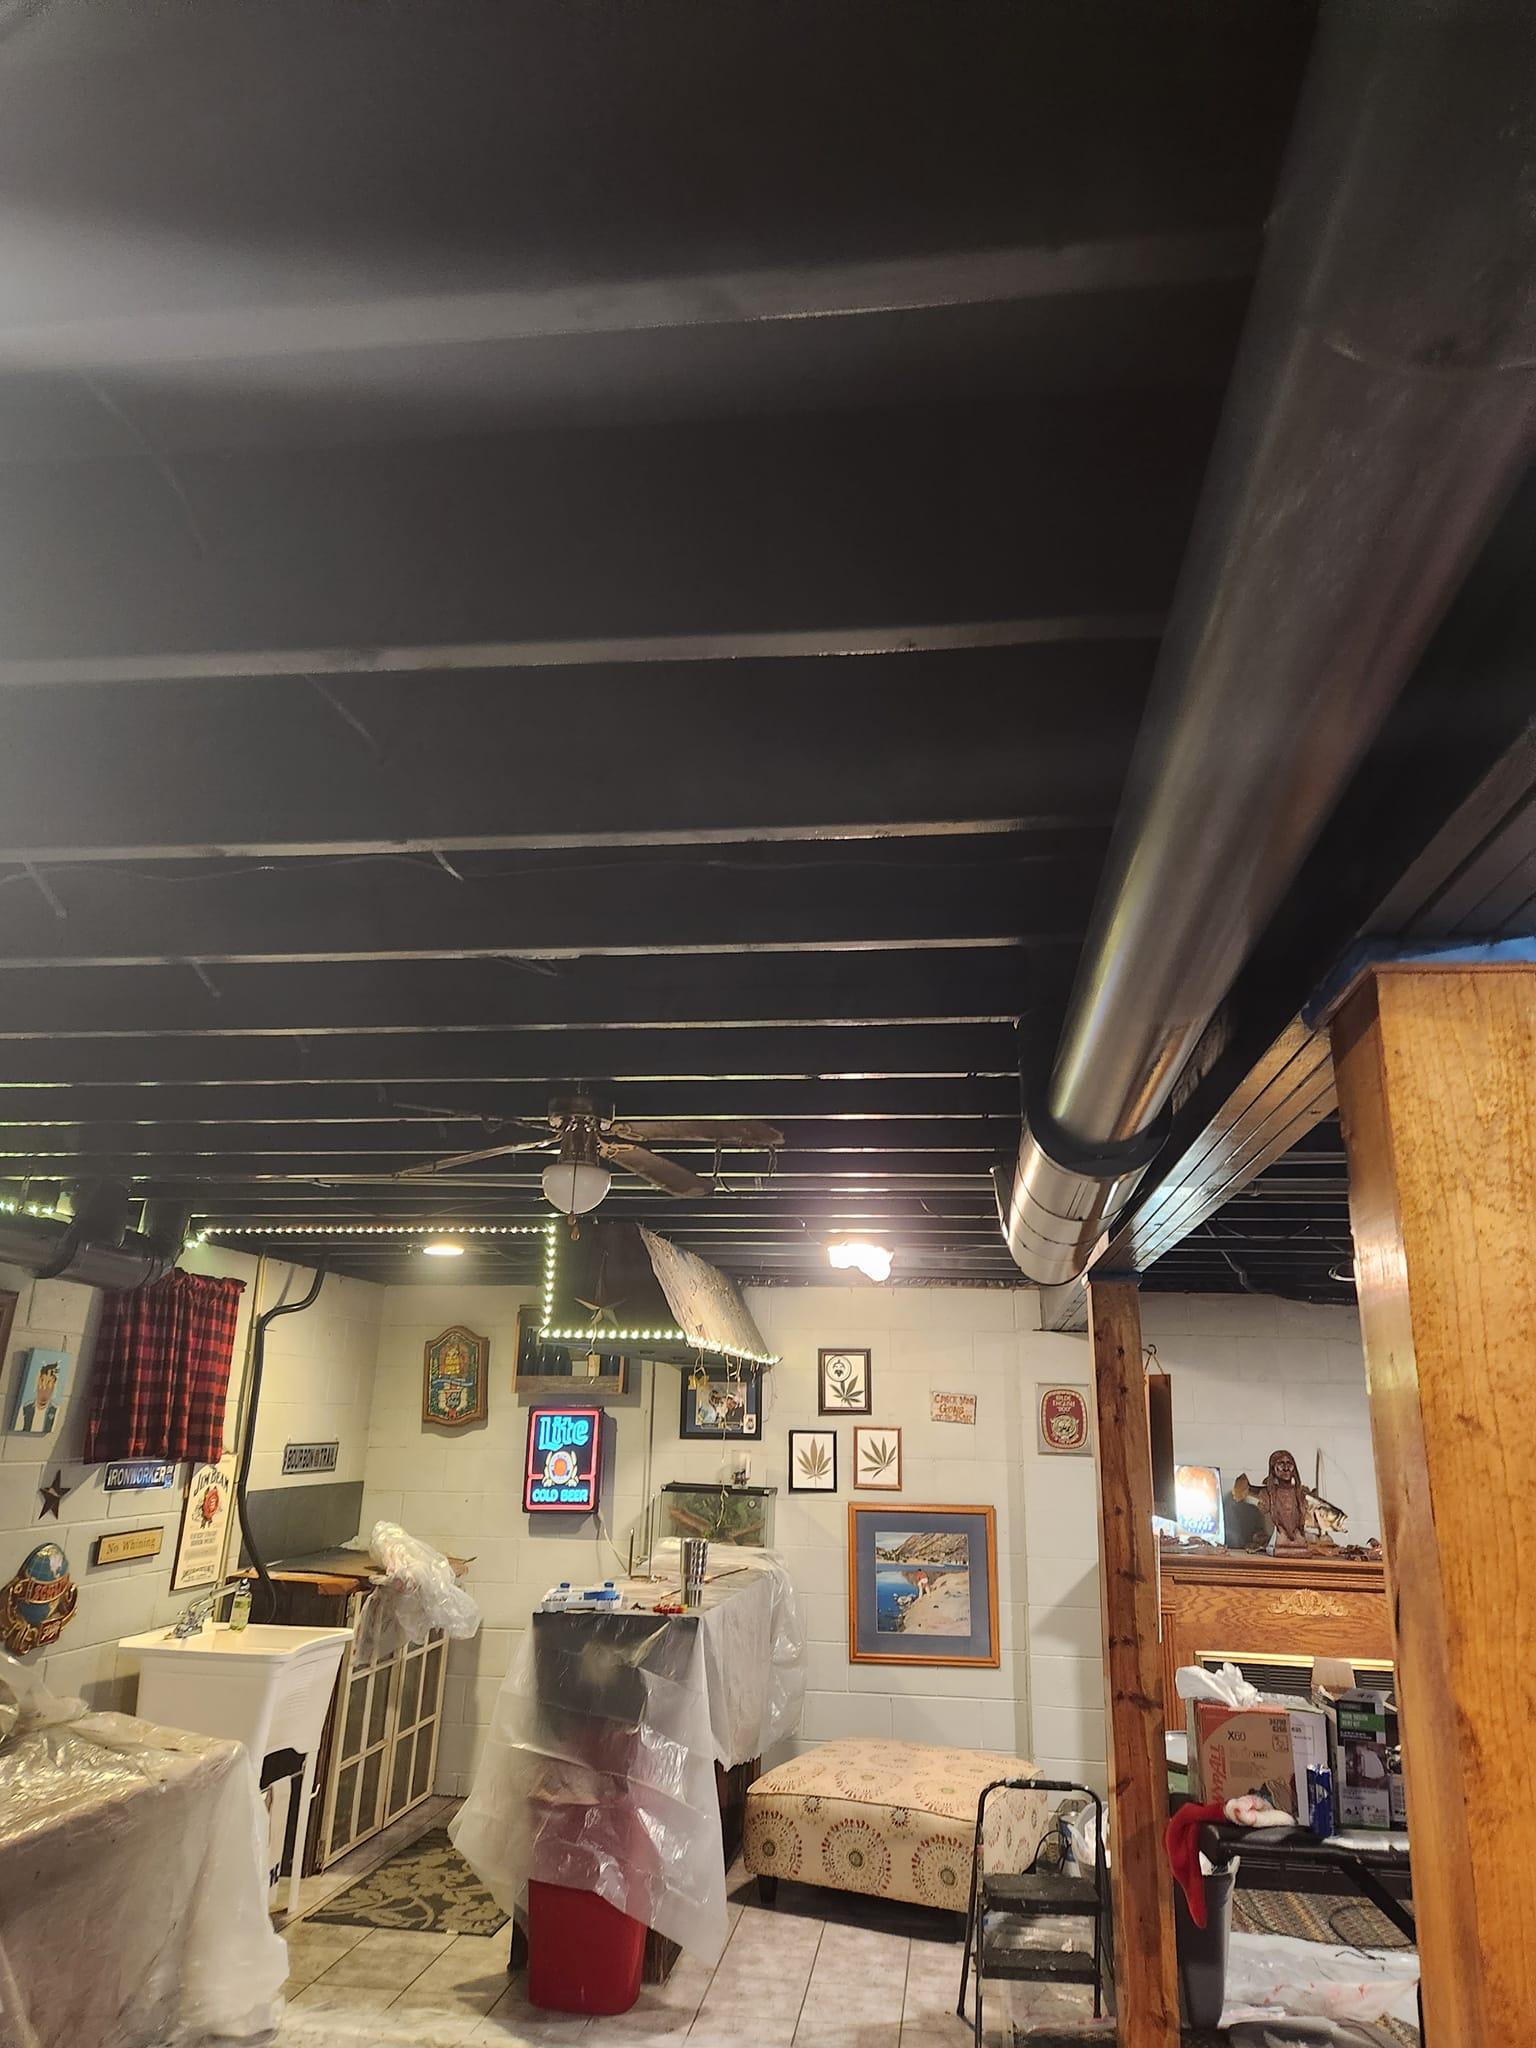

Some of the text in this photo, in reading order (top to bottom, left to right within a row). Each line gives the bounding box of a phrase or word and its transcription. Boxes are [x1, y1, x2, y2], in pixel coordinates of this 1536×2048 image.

[538, 1416, 589, 1451] Lite
[286, 1446, 336, 1470] BOURBON TRAIL
[106, 1465, 167, 1487] IRONWORKER
[532, 1488, 589, 1503] COLD BEER
[105, 1536, 157, 1555] No Whining
[1227, 1730, 1247, 1742] X60
